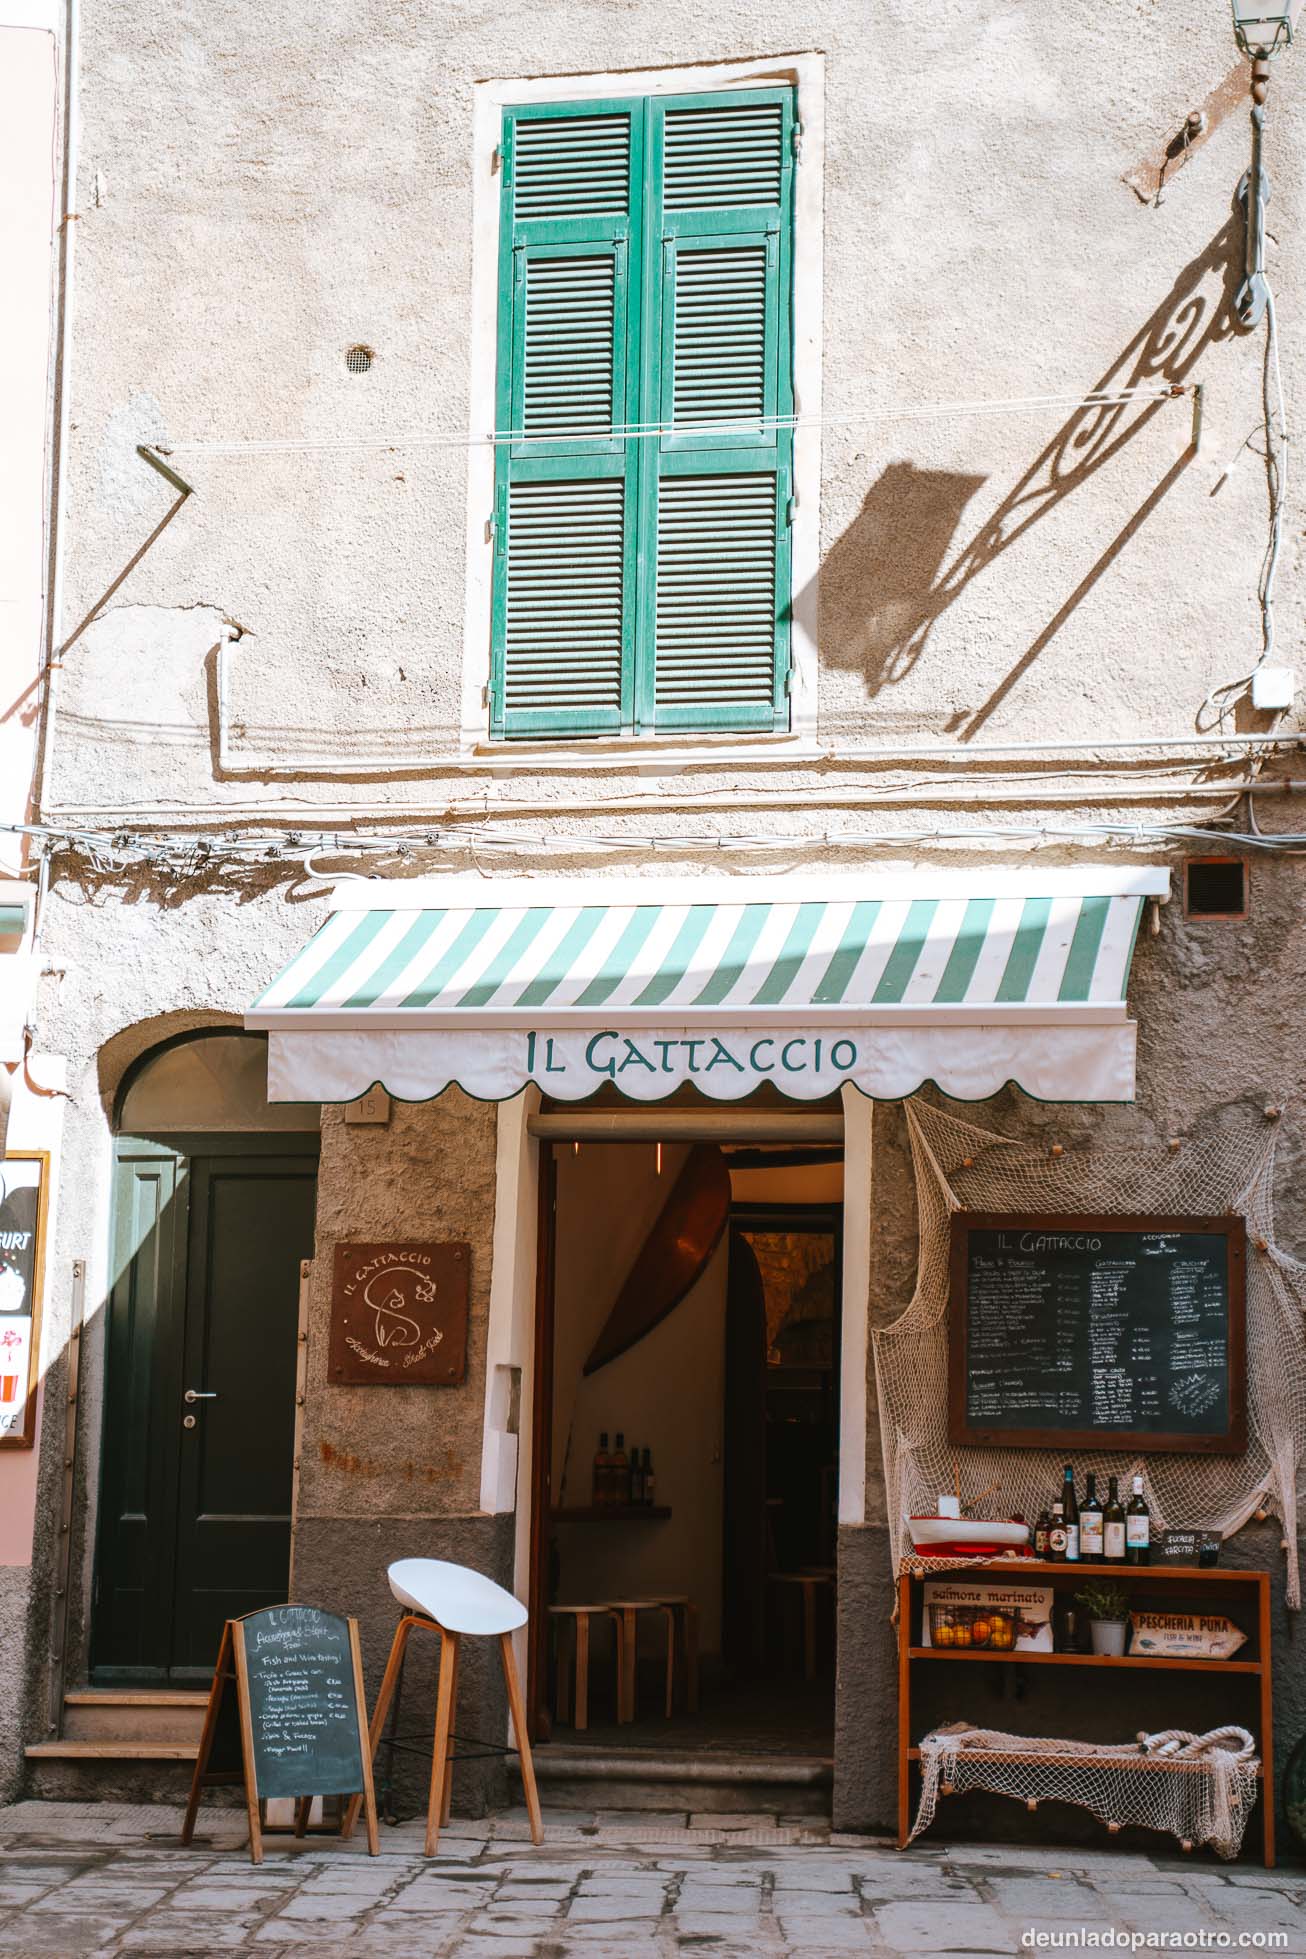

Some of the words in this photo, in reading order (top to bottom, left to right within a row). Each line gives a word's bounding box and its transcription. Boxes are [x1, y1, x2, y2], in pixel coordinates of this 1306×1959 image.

[527, 1031, 565, 1073] IL
[585, 1031, 857, 1078] GATTACCIO
[360, 1100, 375, 1115] 15
[997, 1233, 1012, 1249] IL
[1020, 1232, 1101, 1252] GATTACCIO
[343, 1284, 357, 1296] IL
[356, 1252, 431, 1281] GATTACCIO
[932, 1587, 981, 1601] salmone
[987, 1590, 1045, 1604] marinato
[1139, 1615, 1194, 1631] PESCHERIA
[262, 1656, 281, 1666] Fish
[284, 1655, 297, 1663] and
